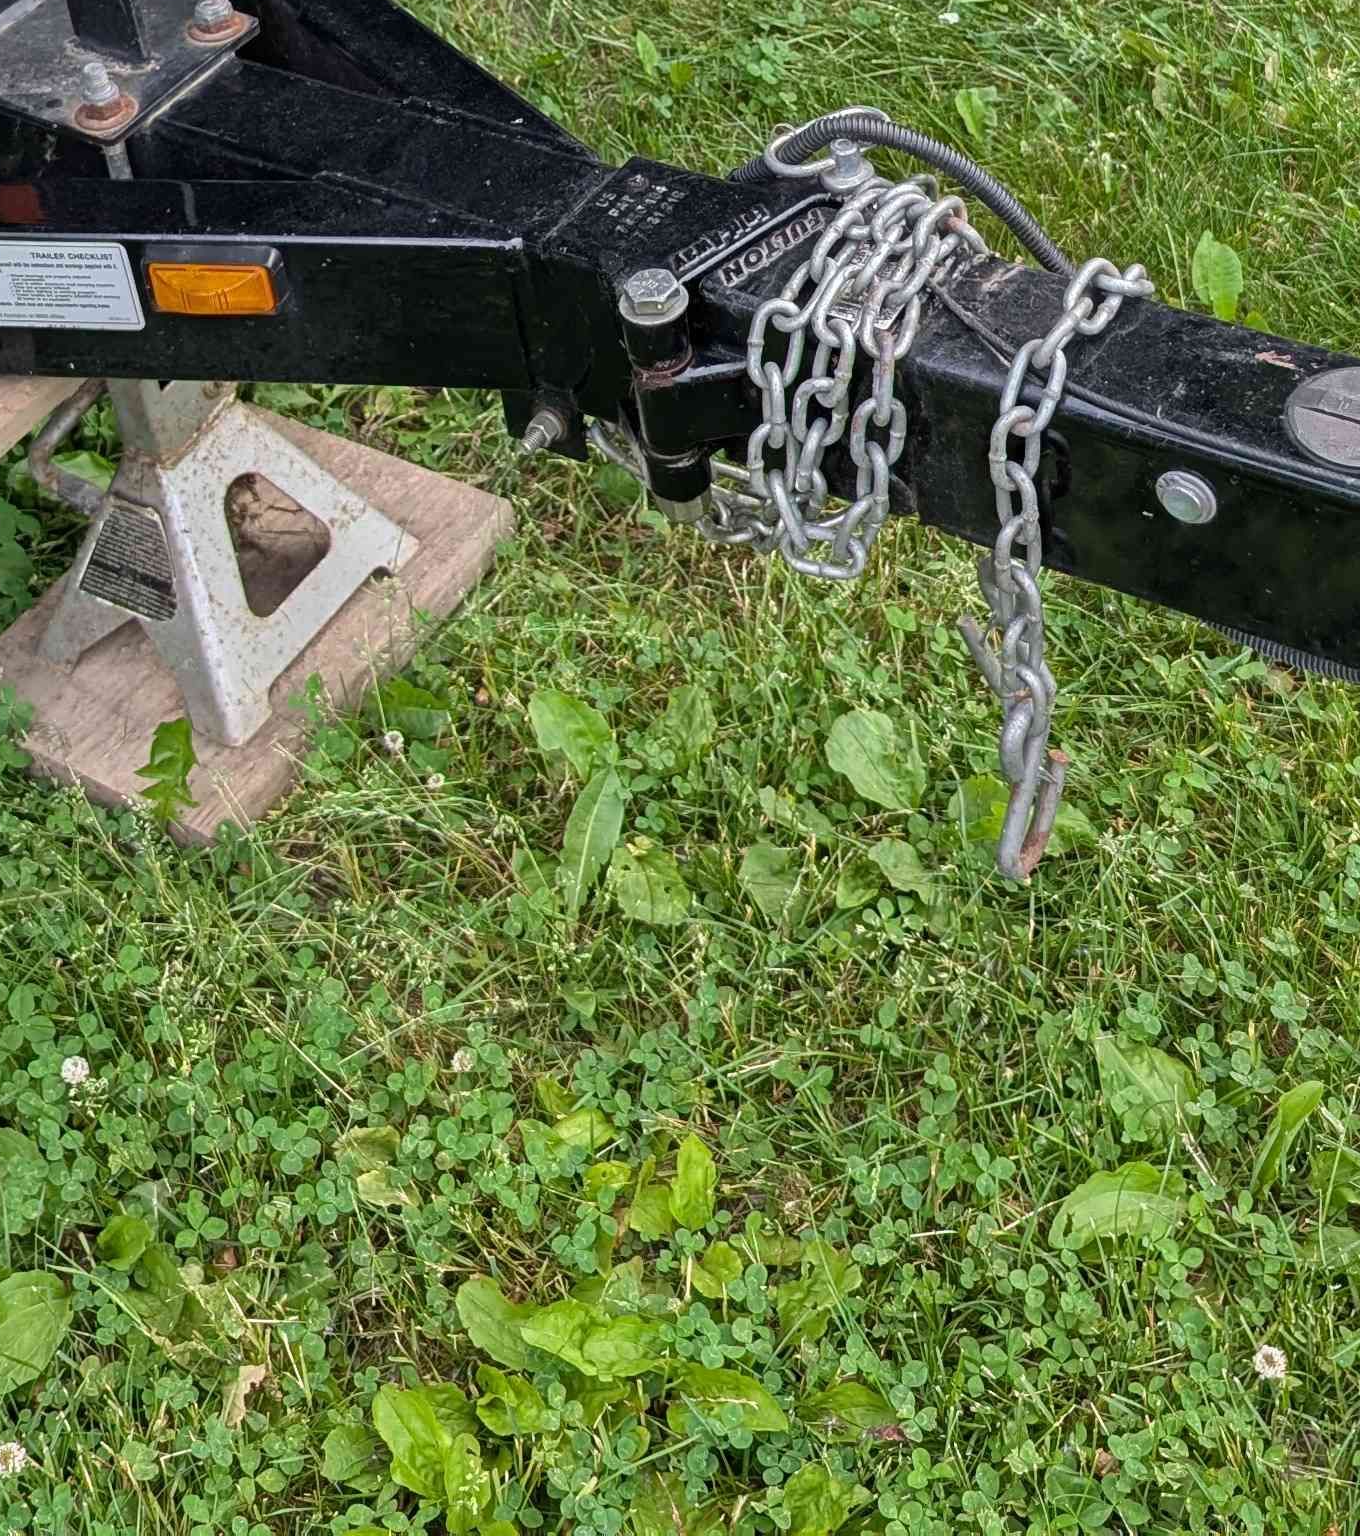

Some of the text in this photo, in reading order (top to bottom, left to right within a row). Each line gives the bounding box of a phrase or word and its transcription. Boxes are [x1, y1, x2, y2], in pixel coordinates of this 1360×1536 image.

[31, 252, 112, 261] TRAILER CHECKLIST
[719, 208, 826, 287] FULTON
